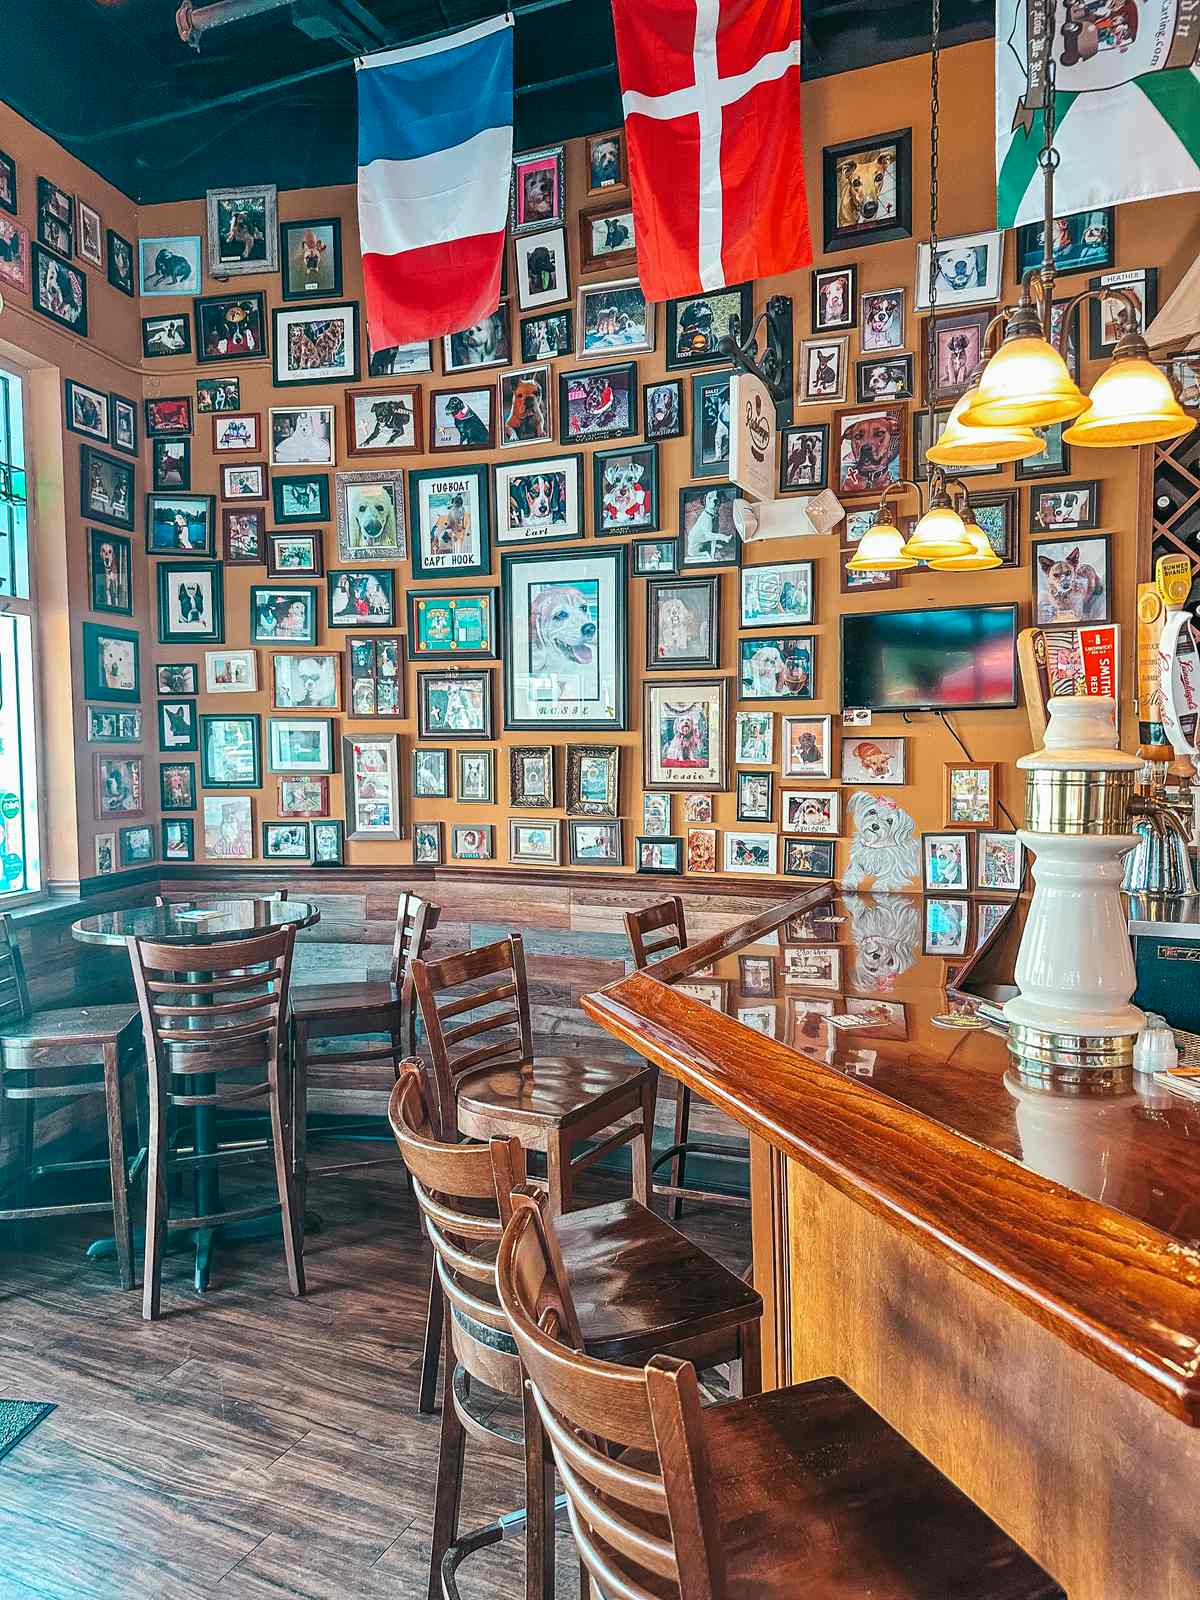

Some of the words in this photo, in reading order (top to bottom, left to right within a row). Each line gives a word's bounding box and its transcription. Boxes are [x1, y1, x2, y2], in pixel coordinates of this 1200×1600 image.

[1028, 60, 1043, 88] Roll
[1107, 272, 1139, 283] HEATHER
[432, 481, 470, 493] TUGBOAT
[525, 527, 549, 537] Earl
[424, 556, 446, 567] CAPT
[452, 554, 475, 565] HOOK
[1090, 675, 1098, 693] RED
